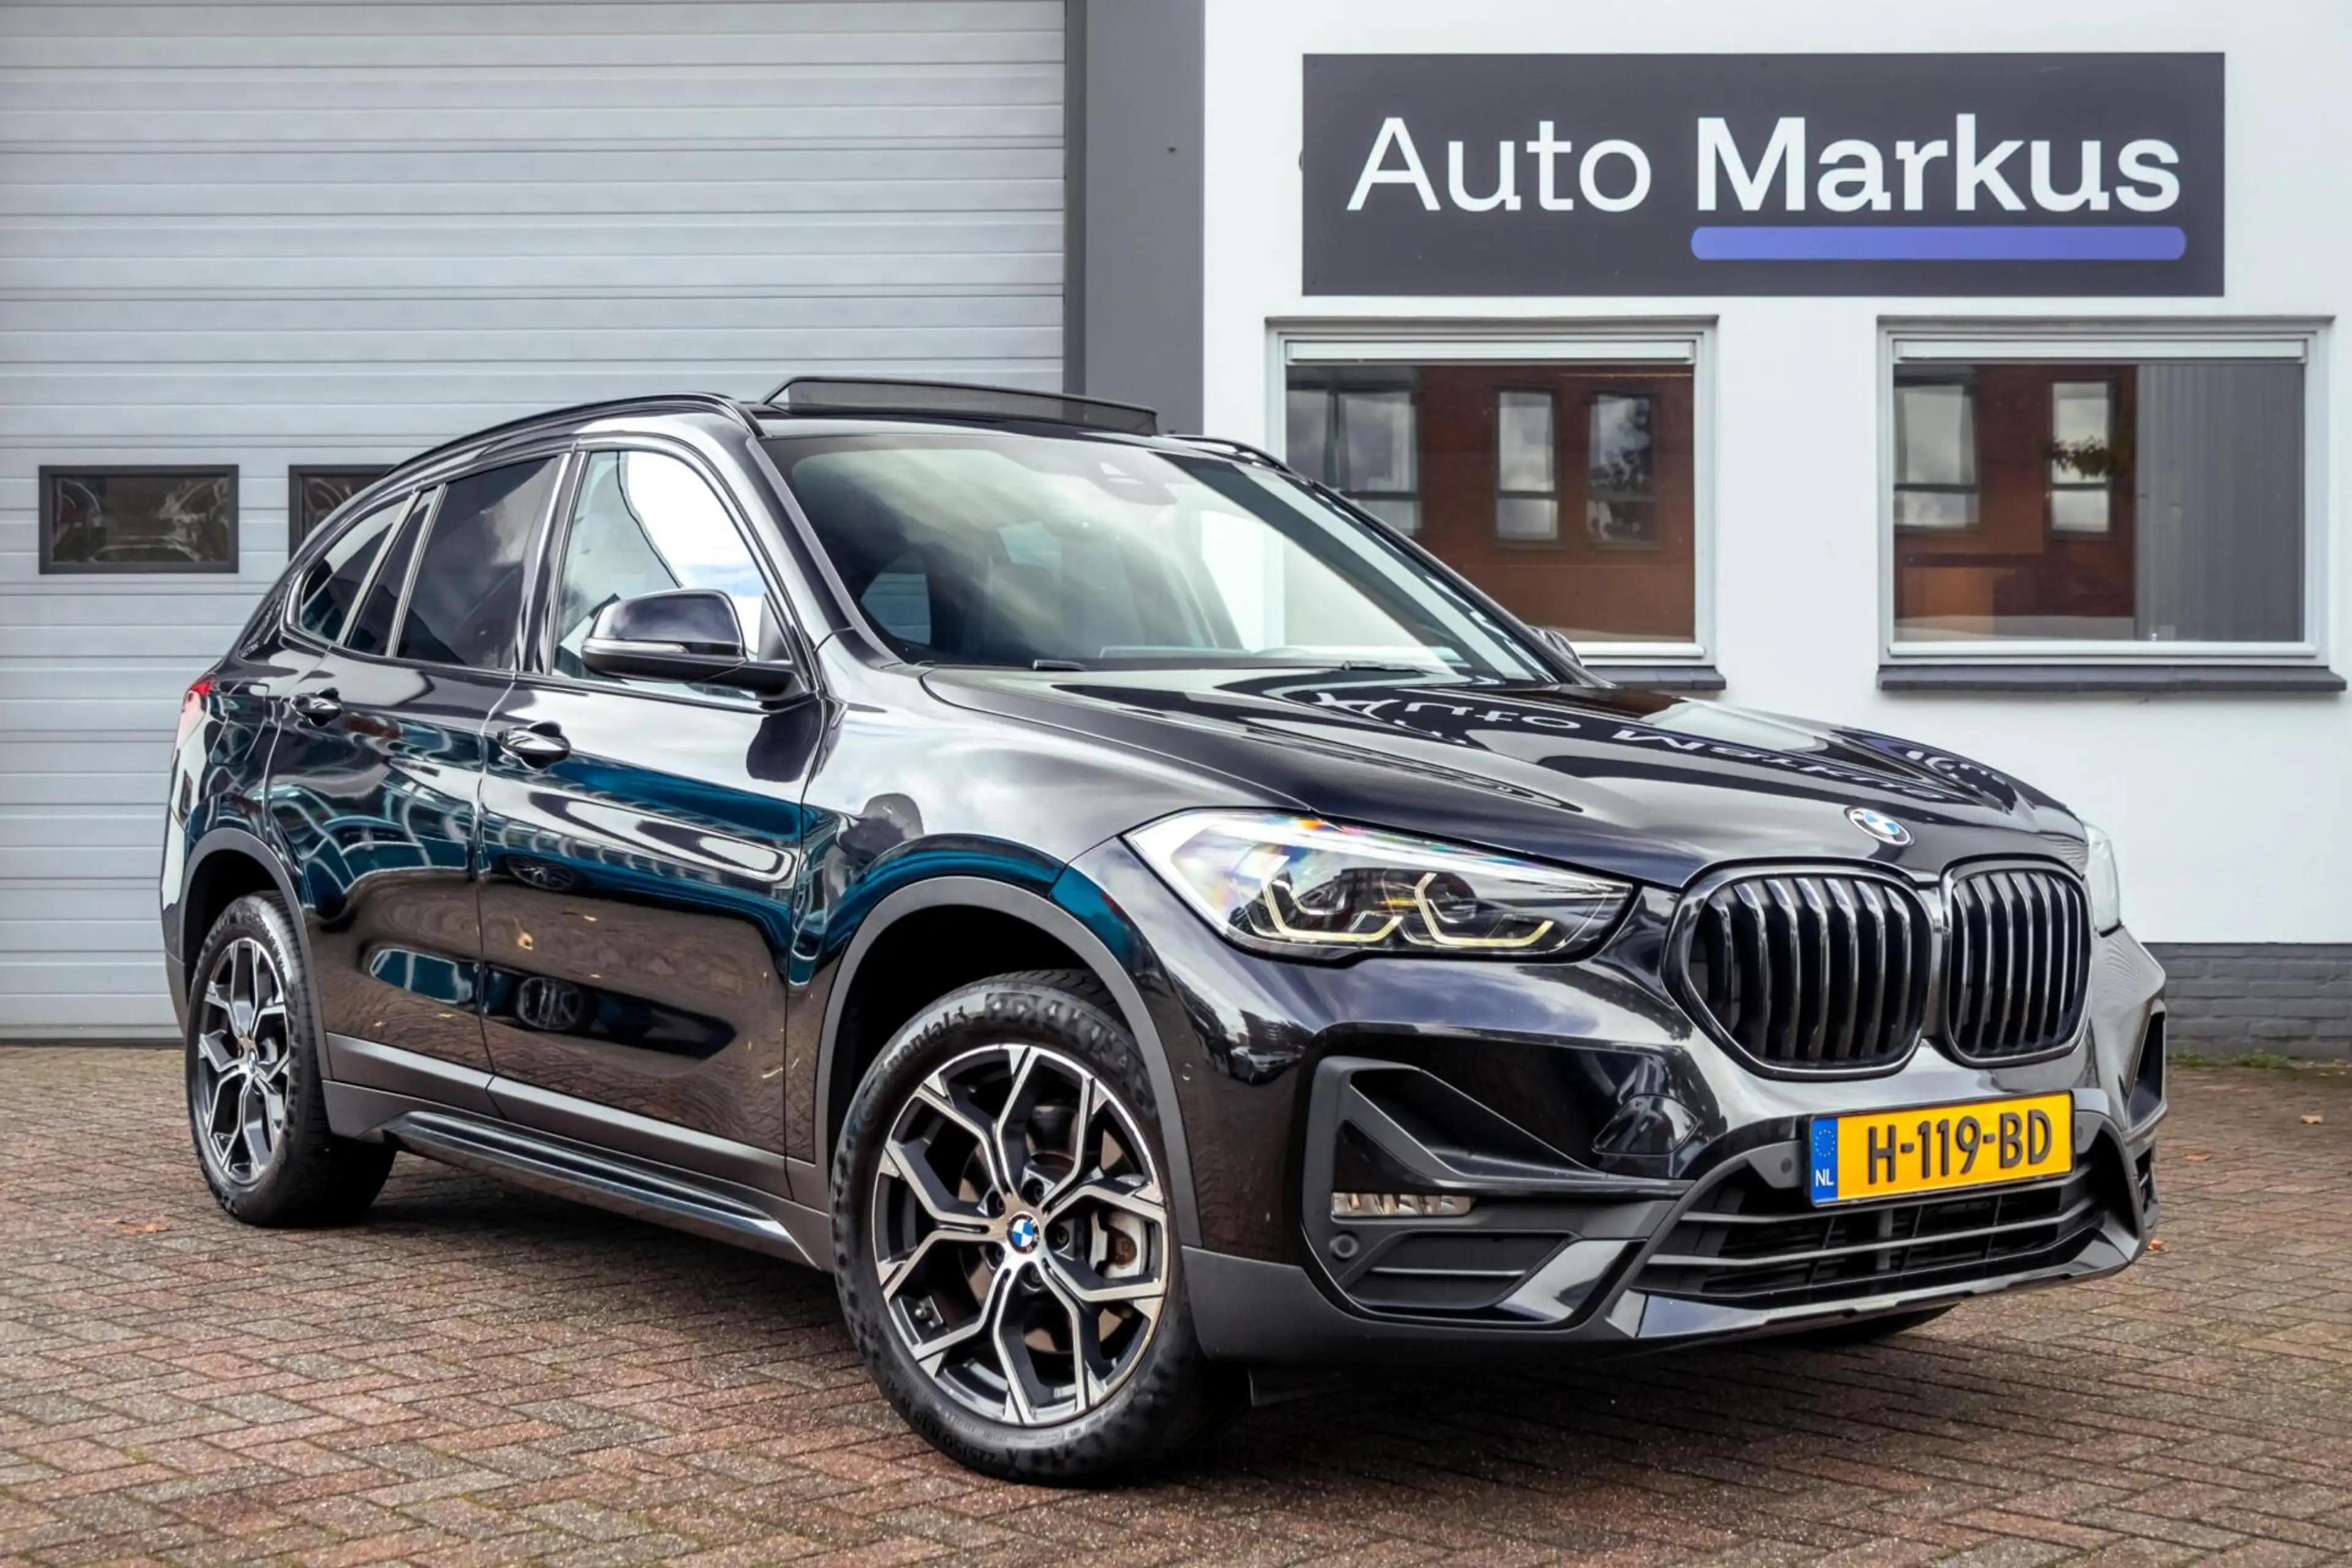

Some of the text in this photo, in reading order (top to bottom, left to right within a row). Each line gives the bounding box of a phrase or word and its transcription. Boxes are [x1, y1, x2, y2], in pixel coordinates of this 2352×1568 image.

[1348, 114, 2179, 211] Auto Markus
[1815, 1169, 1834, 1187] NL
[1868, 1109, 2052, 1185] H-119-BD
